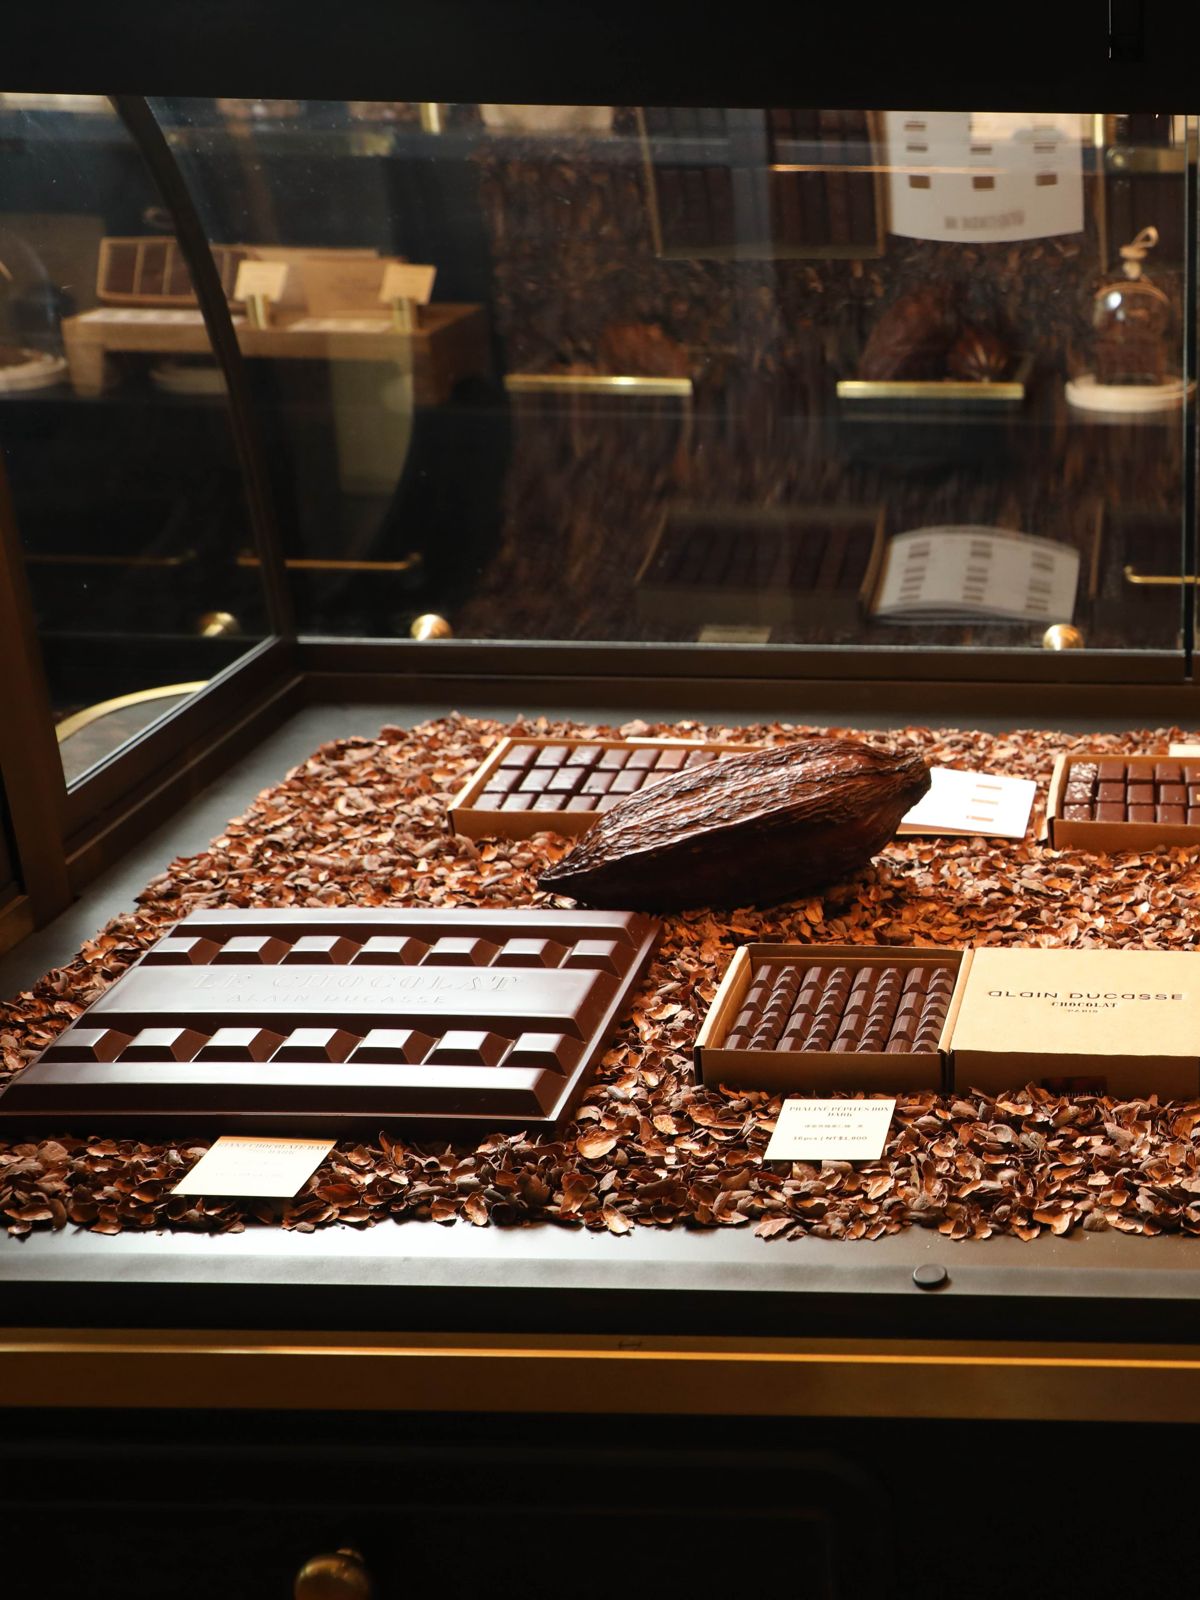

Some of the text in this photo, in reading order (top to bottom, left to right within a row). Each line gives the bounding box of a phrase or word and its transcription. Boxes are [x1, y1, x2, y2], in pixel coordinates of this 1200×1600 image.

[192, 973, 519, 991] LE CHOCOLAT
[1051, 1001, 1119, 1009] CHOCOLAT
